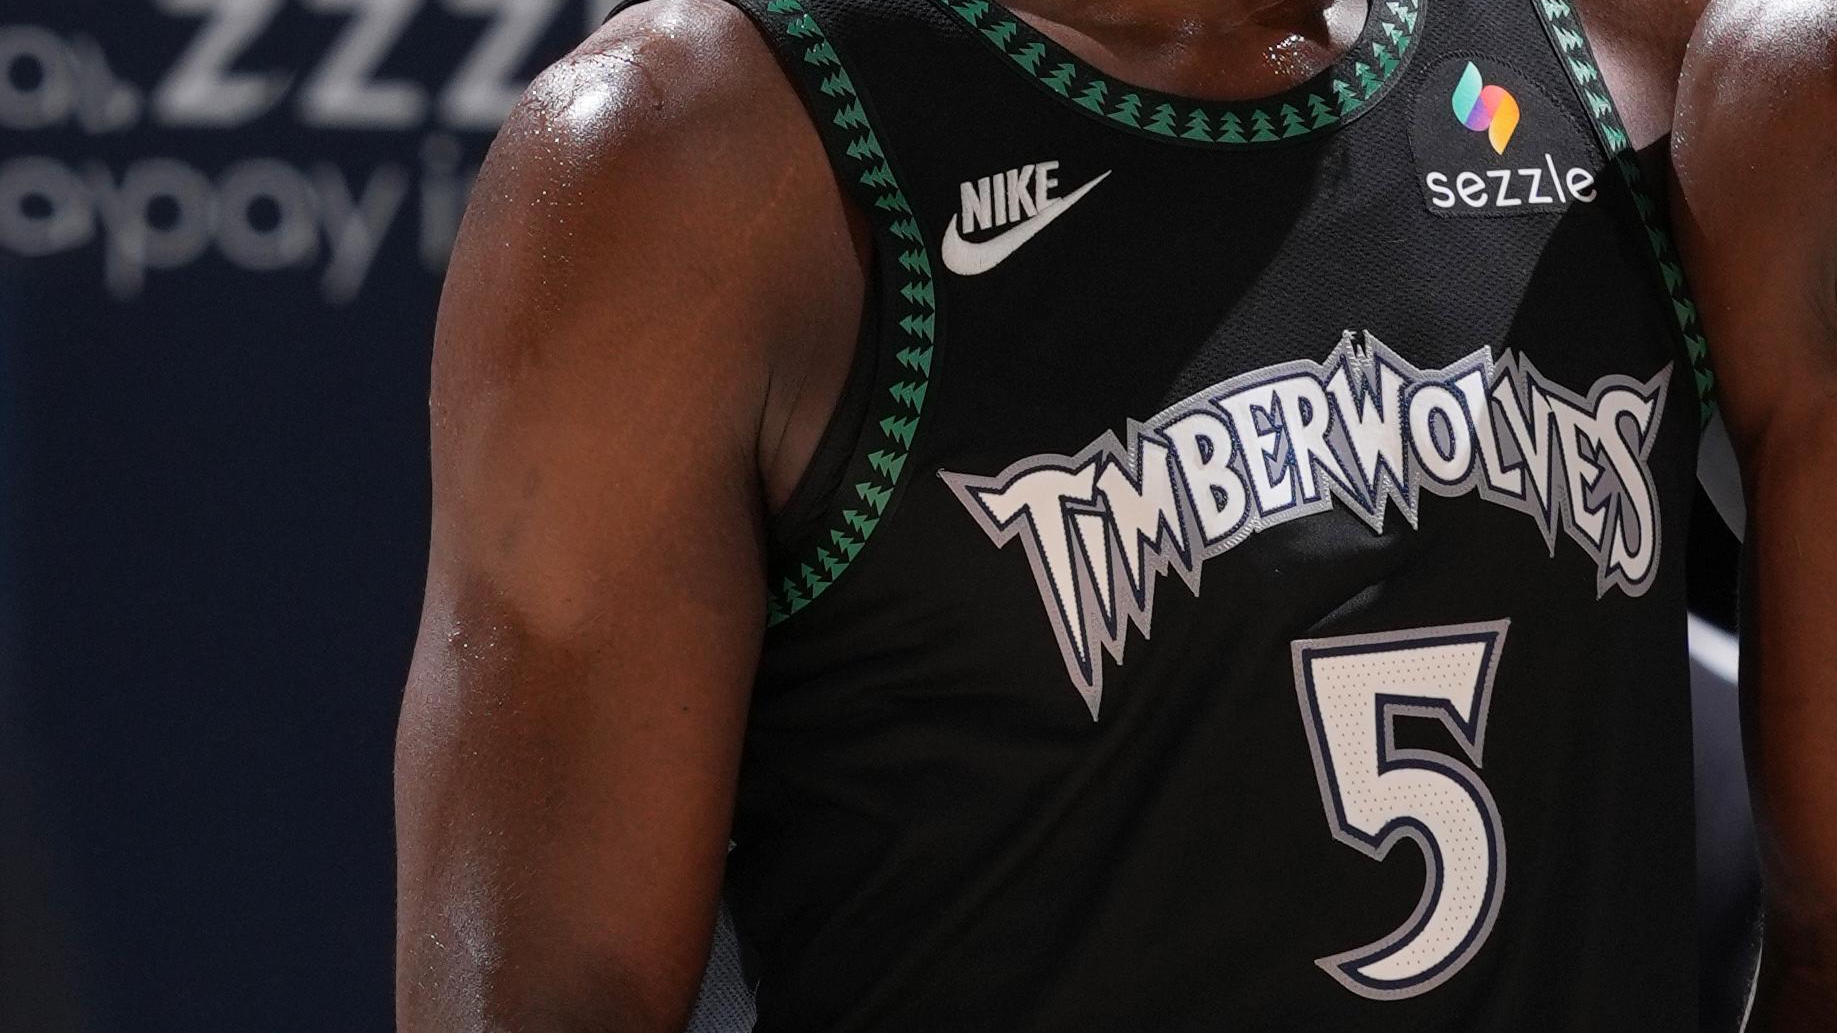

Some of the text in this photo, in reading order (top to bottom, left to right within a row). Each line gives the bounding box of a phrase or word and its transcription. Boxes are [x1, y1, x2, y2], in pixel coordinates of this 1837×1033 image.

[960, 160, 1060, 234] NIKE
[1426, 153, 1598, 208] sezzle
[1291, 618, 1510, 1000] 5
